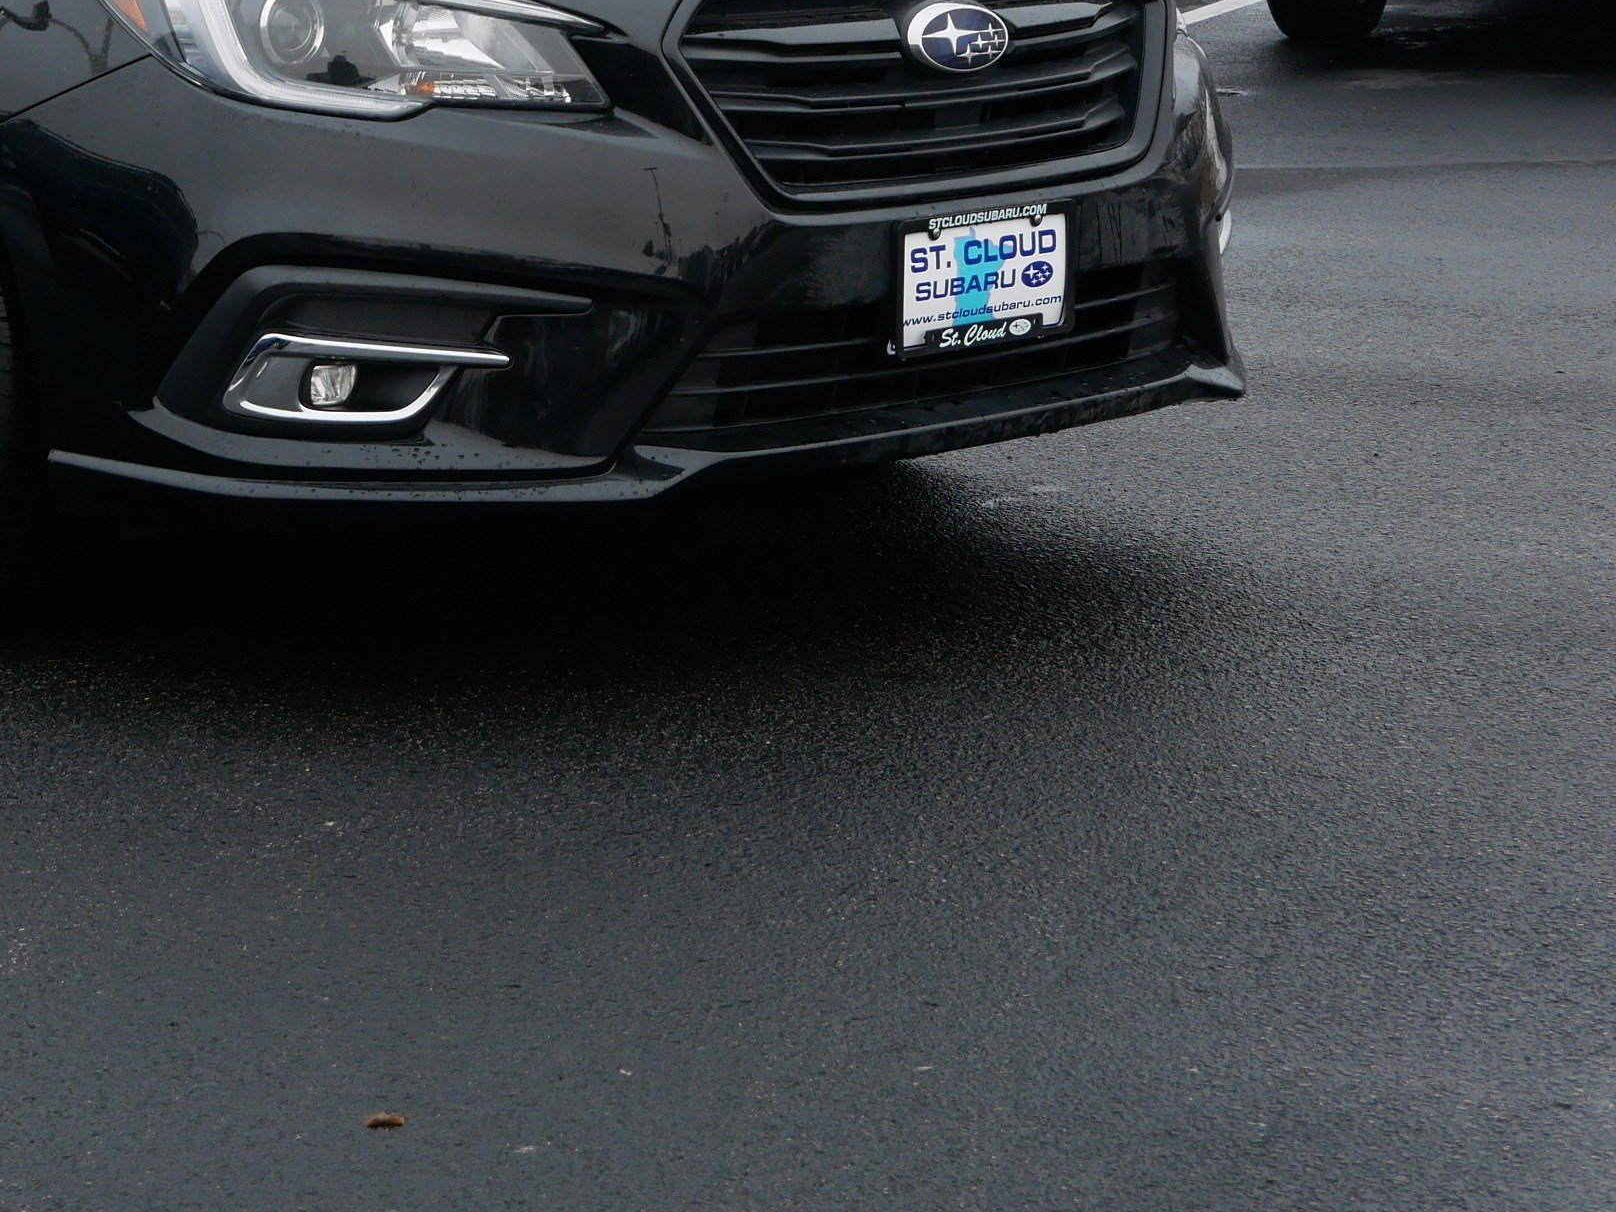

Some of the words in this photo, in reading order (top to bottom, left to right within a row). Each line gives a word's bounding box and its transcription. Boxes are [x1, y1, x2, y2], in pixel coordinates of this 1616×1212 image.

[928, 203, 1048, 230] STCLOUDSUBARU.COM
[910, 245, 952, 273] ST.
[963, 229, 1057, 265] CLOUD
[915, 268, 1016, 302] SUBARU
[903, 294, 1062, 327] www.stcloudsubaru.com
[939, 329, 962, 348] St.
[963, 320, 1007, 347] Cloud
